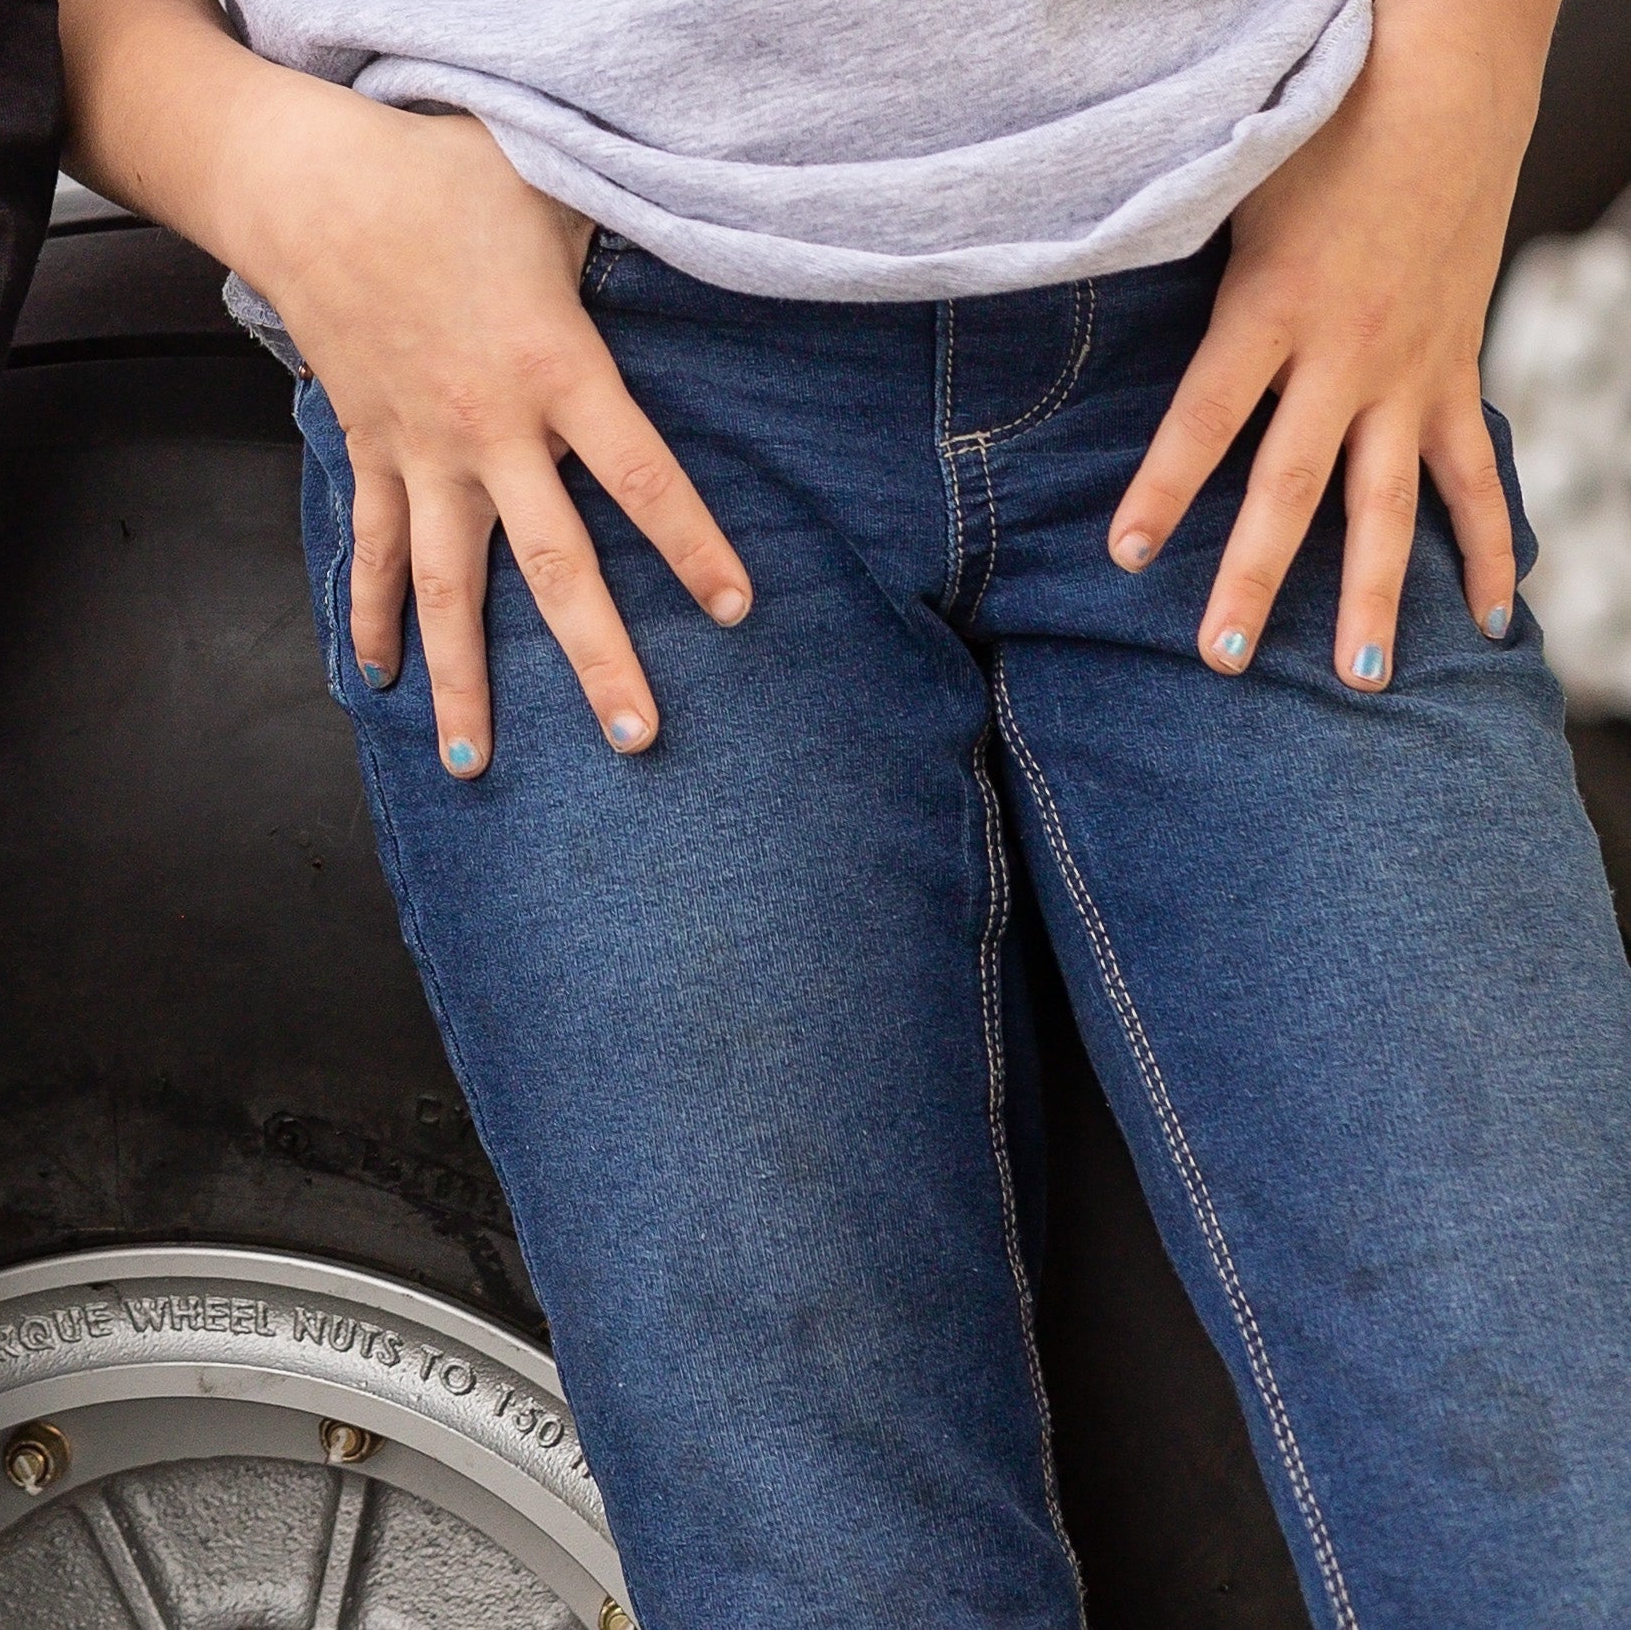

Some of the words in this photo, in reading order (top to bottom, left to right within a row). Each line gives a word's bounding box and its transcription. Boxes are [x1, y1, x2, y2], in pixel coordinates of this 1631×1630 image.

[122, 1294, 277, 1338] WHEEL
[292, 1306, 404, 1368] NUTS
[420, 1343, 477, 1397] TO
